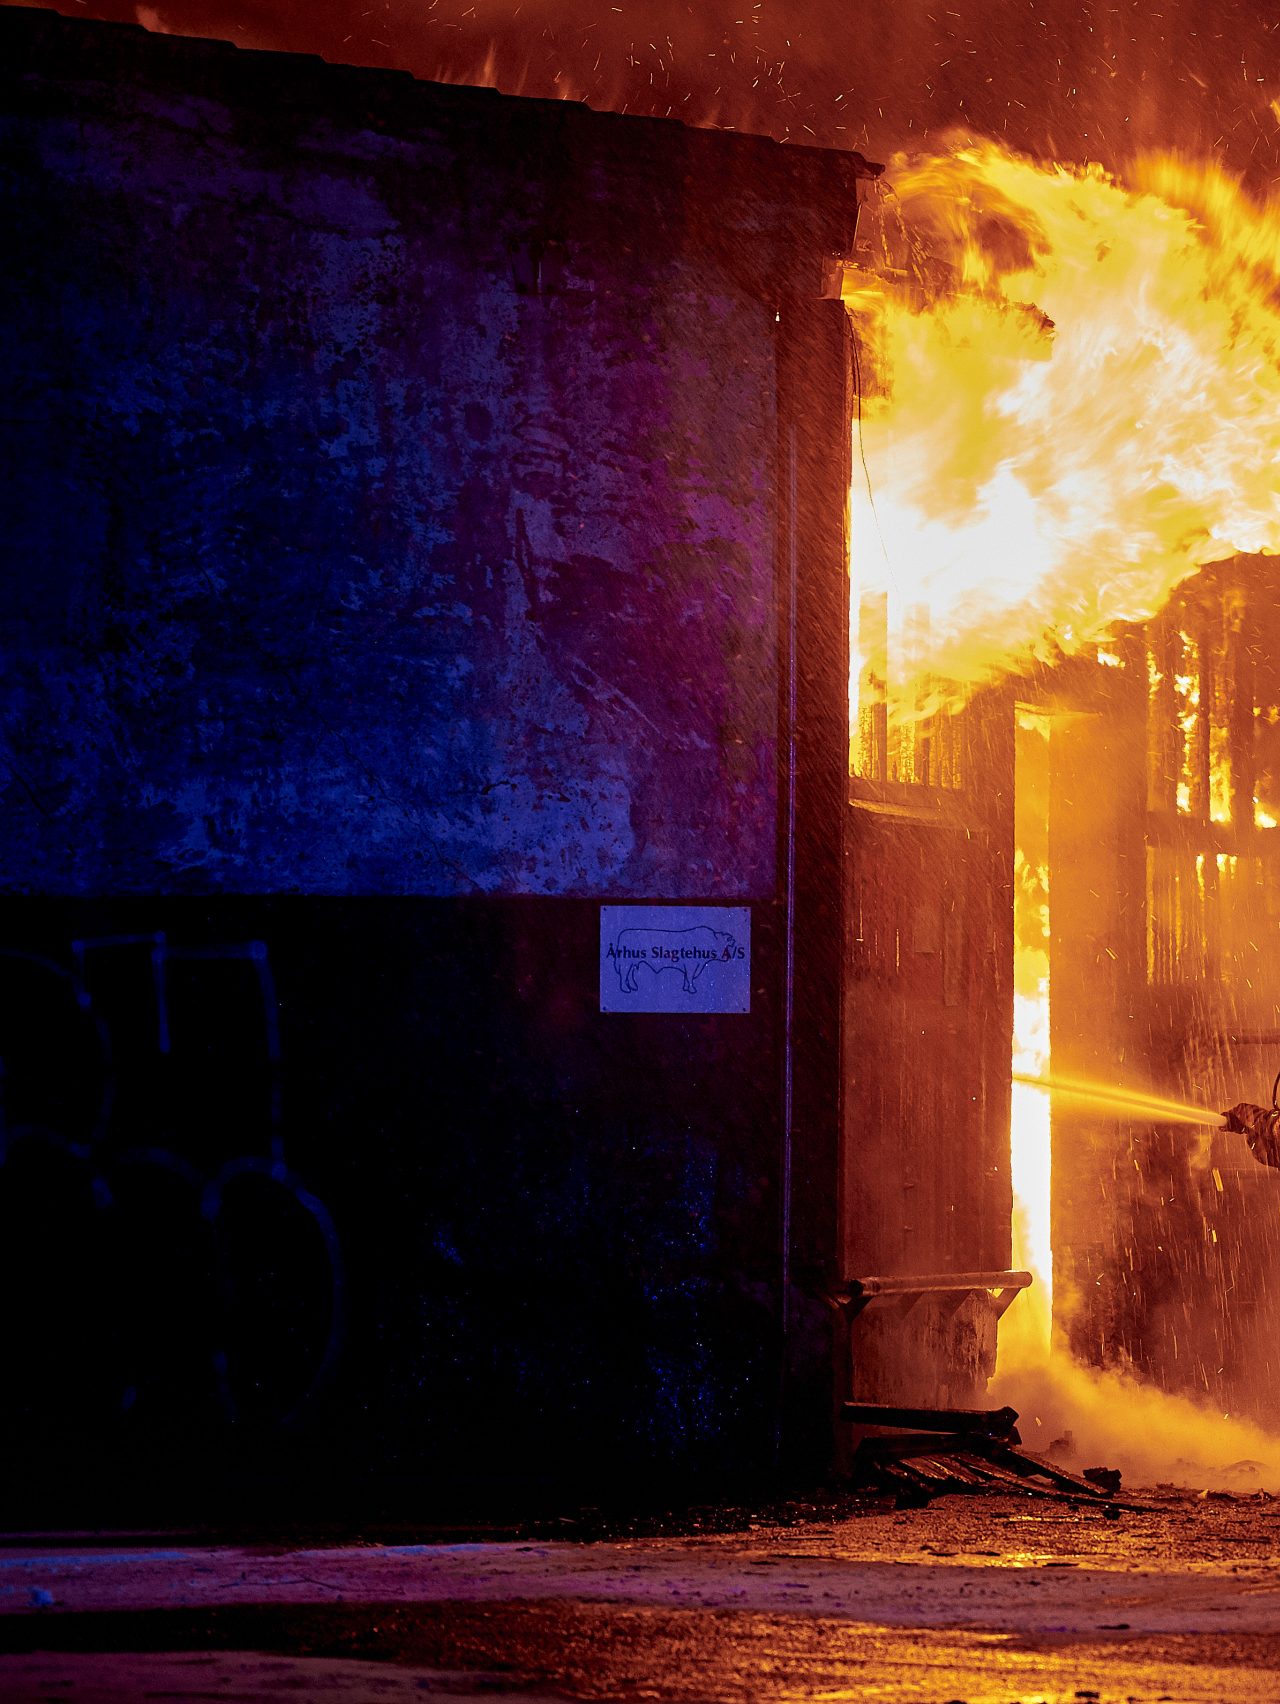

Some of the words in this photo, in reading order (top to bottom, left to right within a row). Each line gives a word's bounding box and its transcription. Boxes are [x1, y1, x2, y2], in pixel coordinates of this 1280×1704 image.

[606, 942, 646, 958] Århus
[651, 946, 717, 962] Slagtehus
[721, 946, 745, 959] A/S
